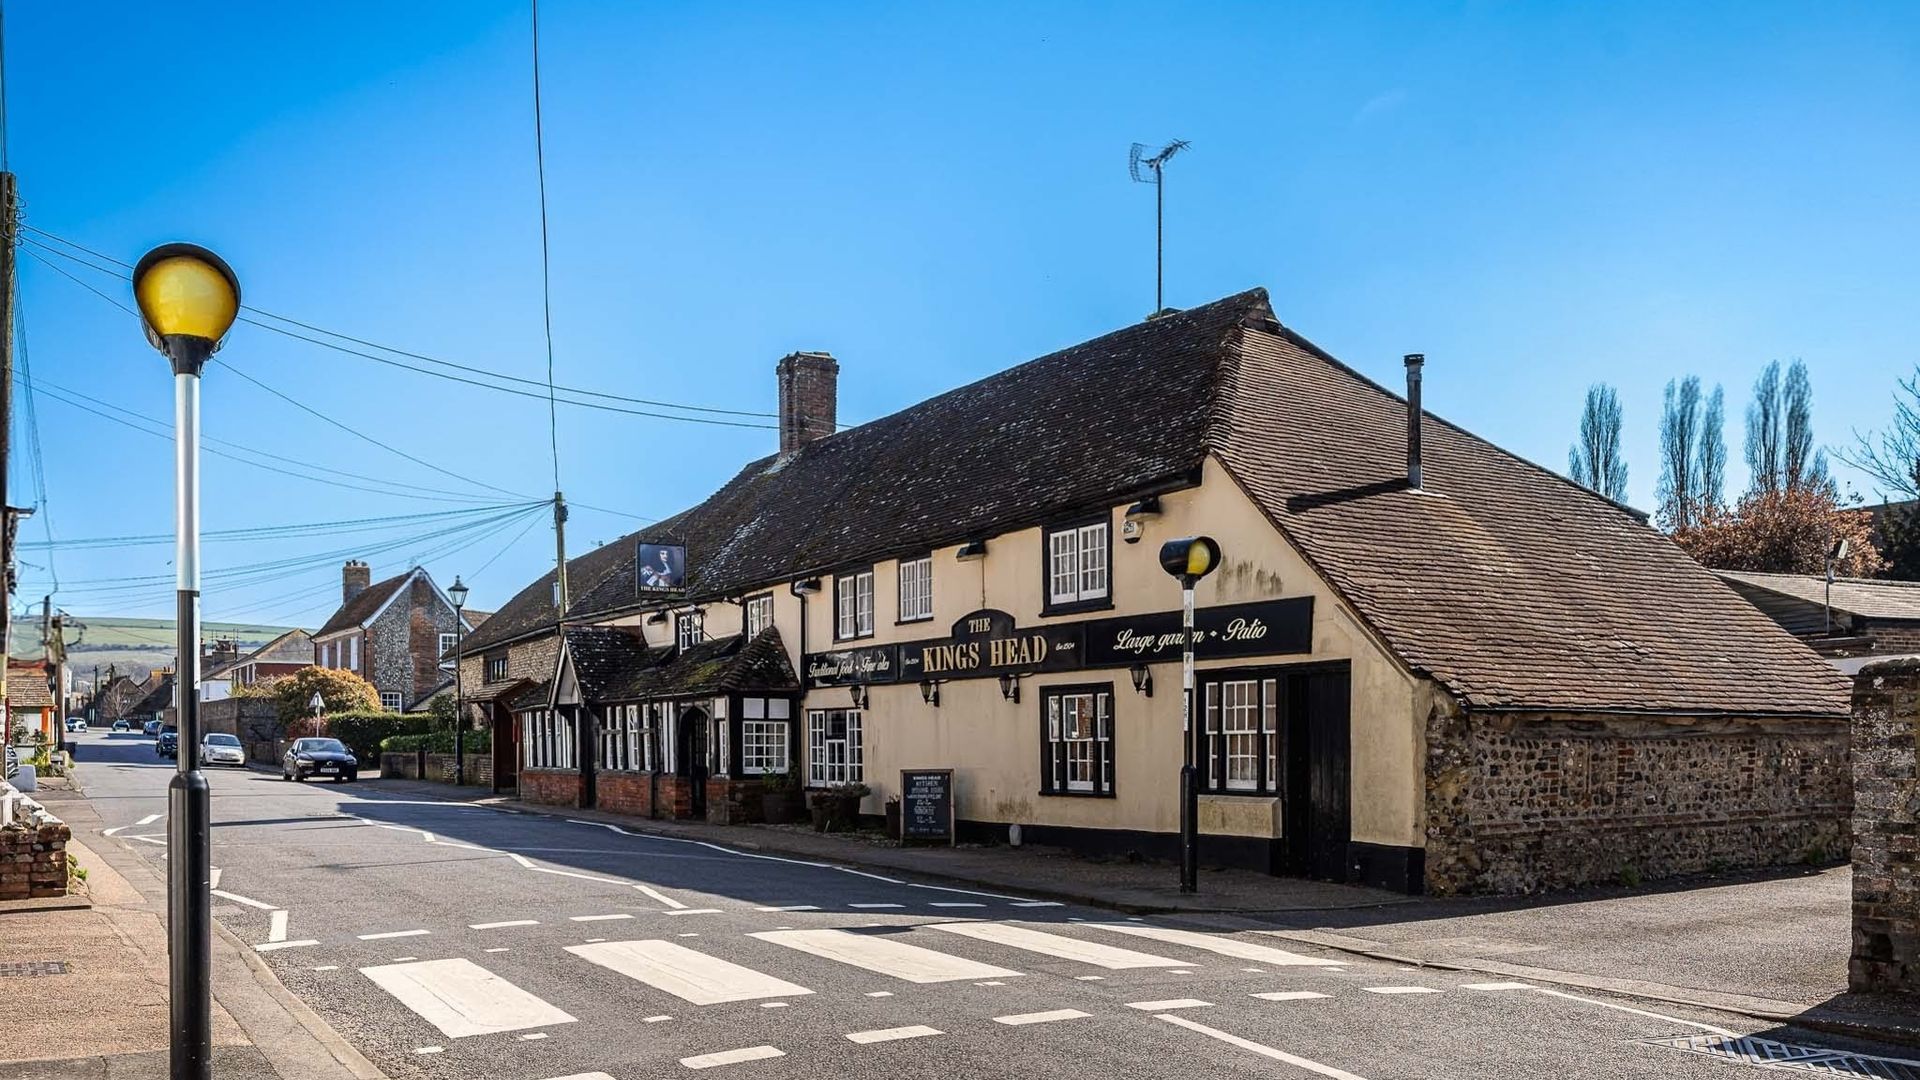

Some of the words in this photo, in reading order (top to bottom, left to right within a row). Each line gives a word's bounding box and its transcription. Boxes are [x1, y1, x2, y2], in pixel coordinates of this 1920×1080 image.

[968, 617, 991, 633] THE
[1112, 628, 1155, 655] Large
[1153, 630, 1205, 653] garn
[1222, 617, 1268, 642] Patio
[836, 659, 854, 679] food
[860, 656, 877, 673] Fine
[922, 642, 980, 673] KINGS
[989, 635, 1048, 667] HEAD
